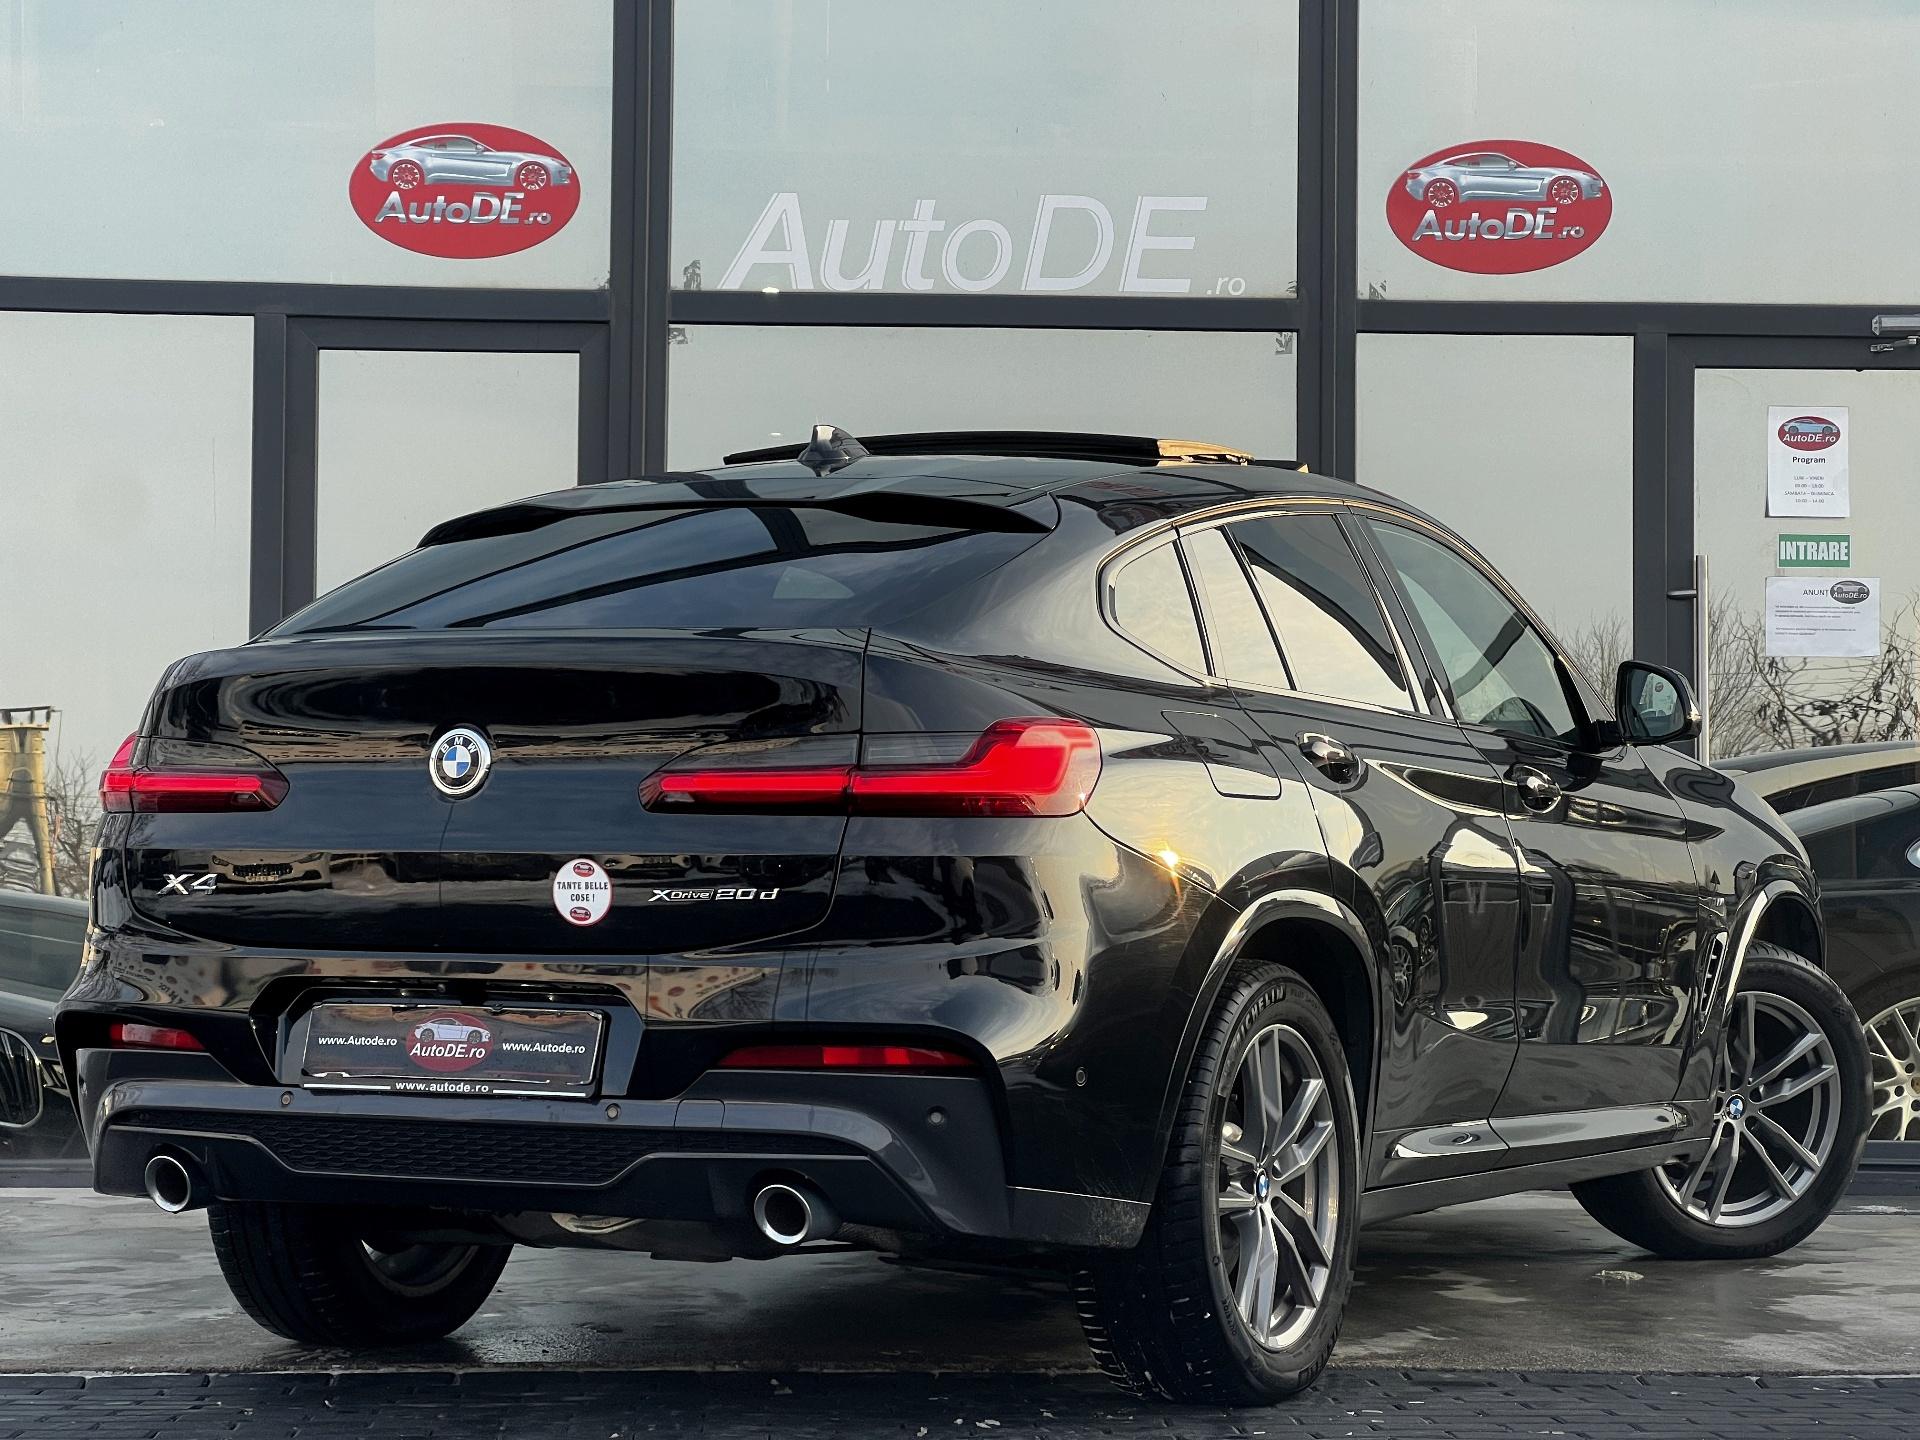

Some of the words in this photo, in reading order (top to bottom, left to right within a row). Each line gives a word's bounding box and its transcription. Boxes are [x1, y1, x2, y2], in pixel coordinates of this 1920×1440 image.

[1782, 433, 1836, 443] AutoDE.ro
[1792, 456, 1826, 464] Program
[1780, 541, 1849, 561] INTRARE
[440, 737, 478, 753] BMW
[156, 873, 218, 895] X4
[557, 881, 582, 890] TANTE
[585, 881, 609, 890] BELLE
[571, 893, 590, 902] COSE
[318, 1035, 397, 1046] www.Autode.ro
[410, 1042, 486, 1059] AutoDE.ro
[502, 1041, 586, 1054] www.Autode.ro
[395, 1081, 489, 1093] www.autode.ro
